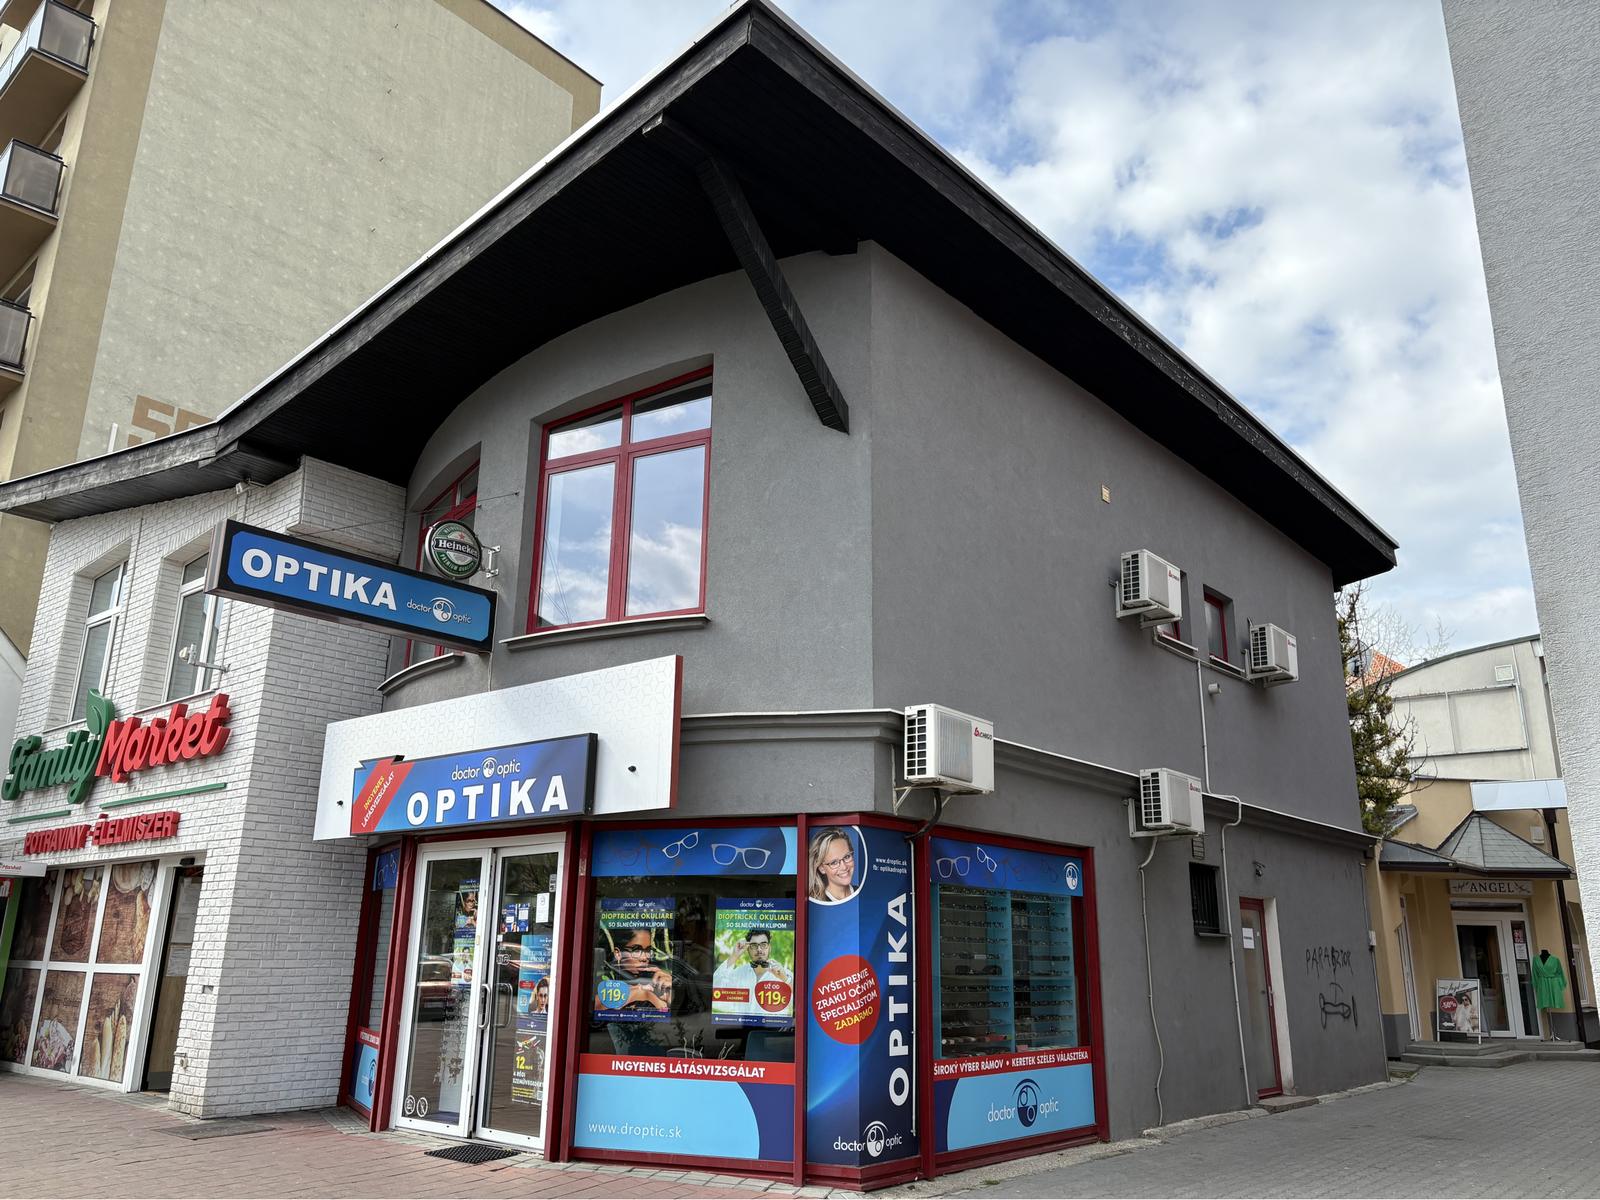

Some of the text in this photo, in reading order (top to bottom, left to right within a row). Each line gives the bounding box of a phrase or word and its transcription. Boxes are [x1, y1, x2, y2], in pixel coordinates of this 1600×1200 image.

[242, 548, 397, 611] OPTIKA
[407, 598, 472, 624] doctor optic
[1, 693, 231, 804] Family Market
[452, 759, 521, 781] doctor optic
[363, 776, 385, 810] INGYENES
[406, 775, 569, 826] OPTIKA
[1469, 882, 1514, 893] ANGEL
[601, 912, 674, 920] DIOPTRICKÉ OKULIARE
[718, 912, 793, 921] DIOPTRICKÉ OKULIARE
[815, 977, 876, 1011] ZRAKU OČNÝM
[817, 967, 870, 996] VYŠETRENIE
[820, 989, 878, 1022] ŠPECIALISTOM
[887, 892, 910, 1106] OPTIKA
[834, 1005, 874, 1031] ZADARMO
[515, 1055, 526, 1070] 12
[611, 1060, 766, 1078] INGYENES LÁTÁSVIZSGÁLAT
[933, 1050, 1089, 1076] ŠIROKÝ VÝBER RÁMOV KERETEK SZÉLES VÁLASZTÉKA
[987, 1096, 1059, 1122] doctor optic
[588, 1122, 682, 1139] www.droptic.sk
[833, 1133, 903, 1152] doctor optic
